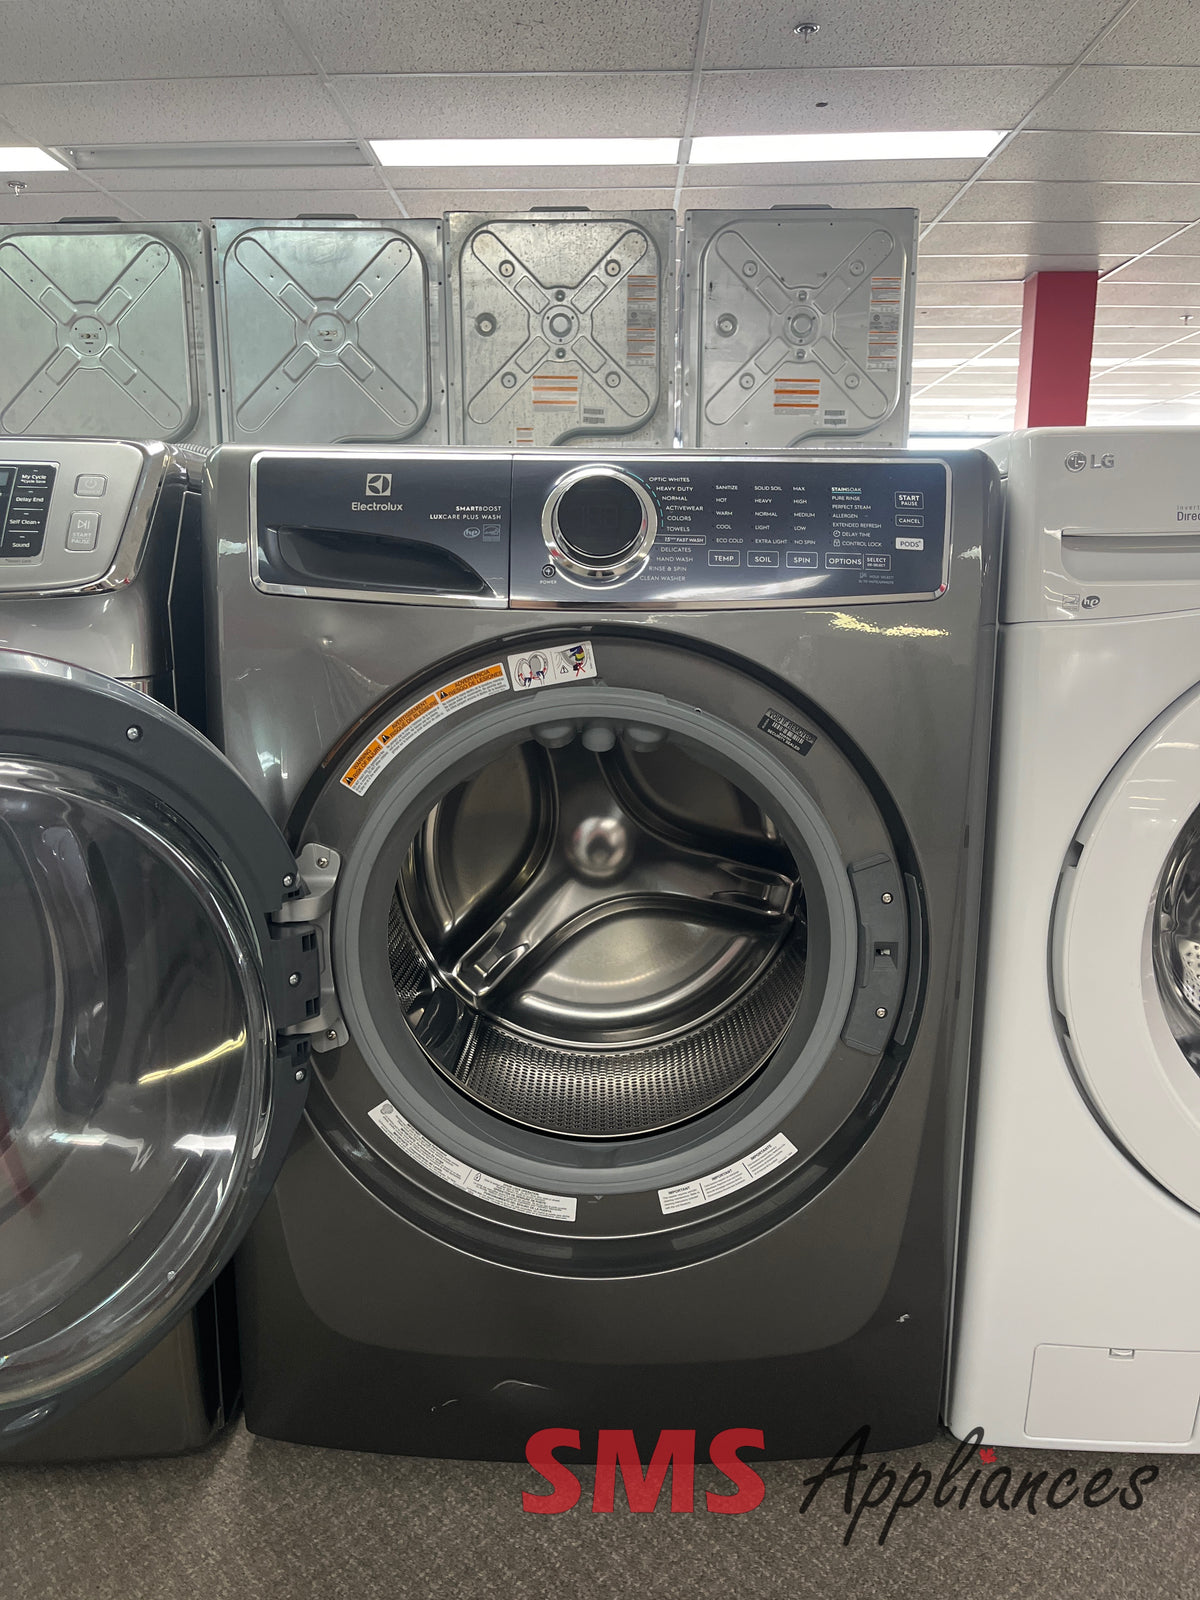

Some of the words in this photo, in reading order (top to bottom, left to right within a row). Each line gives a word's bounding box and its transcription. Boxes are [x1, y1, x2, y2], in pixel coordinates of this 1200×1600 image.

[1090, 453, 1114, 468] LG
[352, 502, 403, 510] Electrolux
[750, 1144, 772, 1160] IMPORTANTE
[712, 1169, 732, 1181] IMPORTANT
[668, 1186, 690, 1194] IMPORTANT
